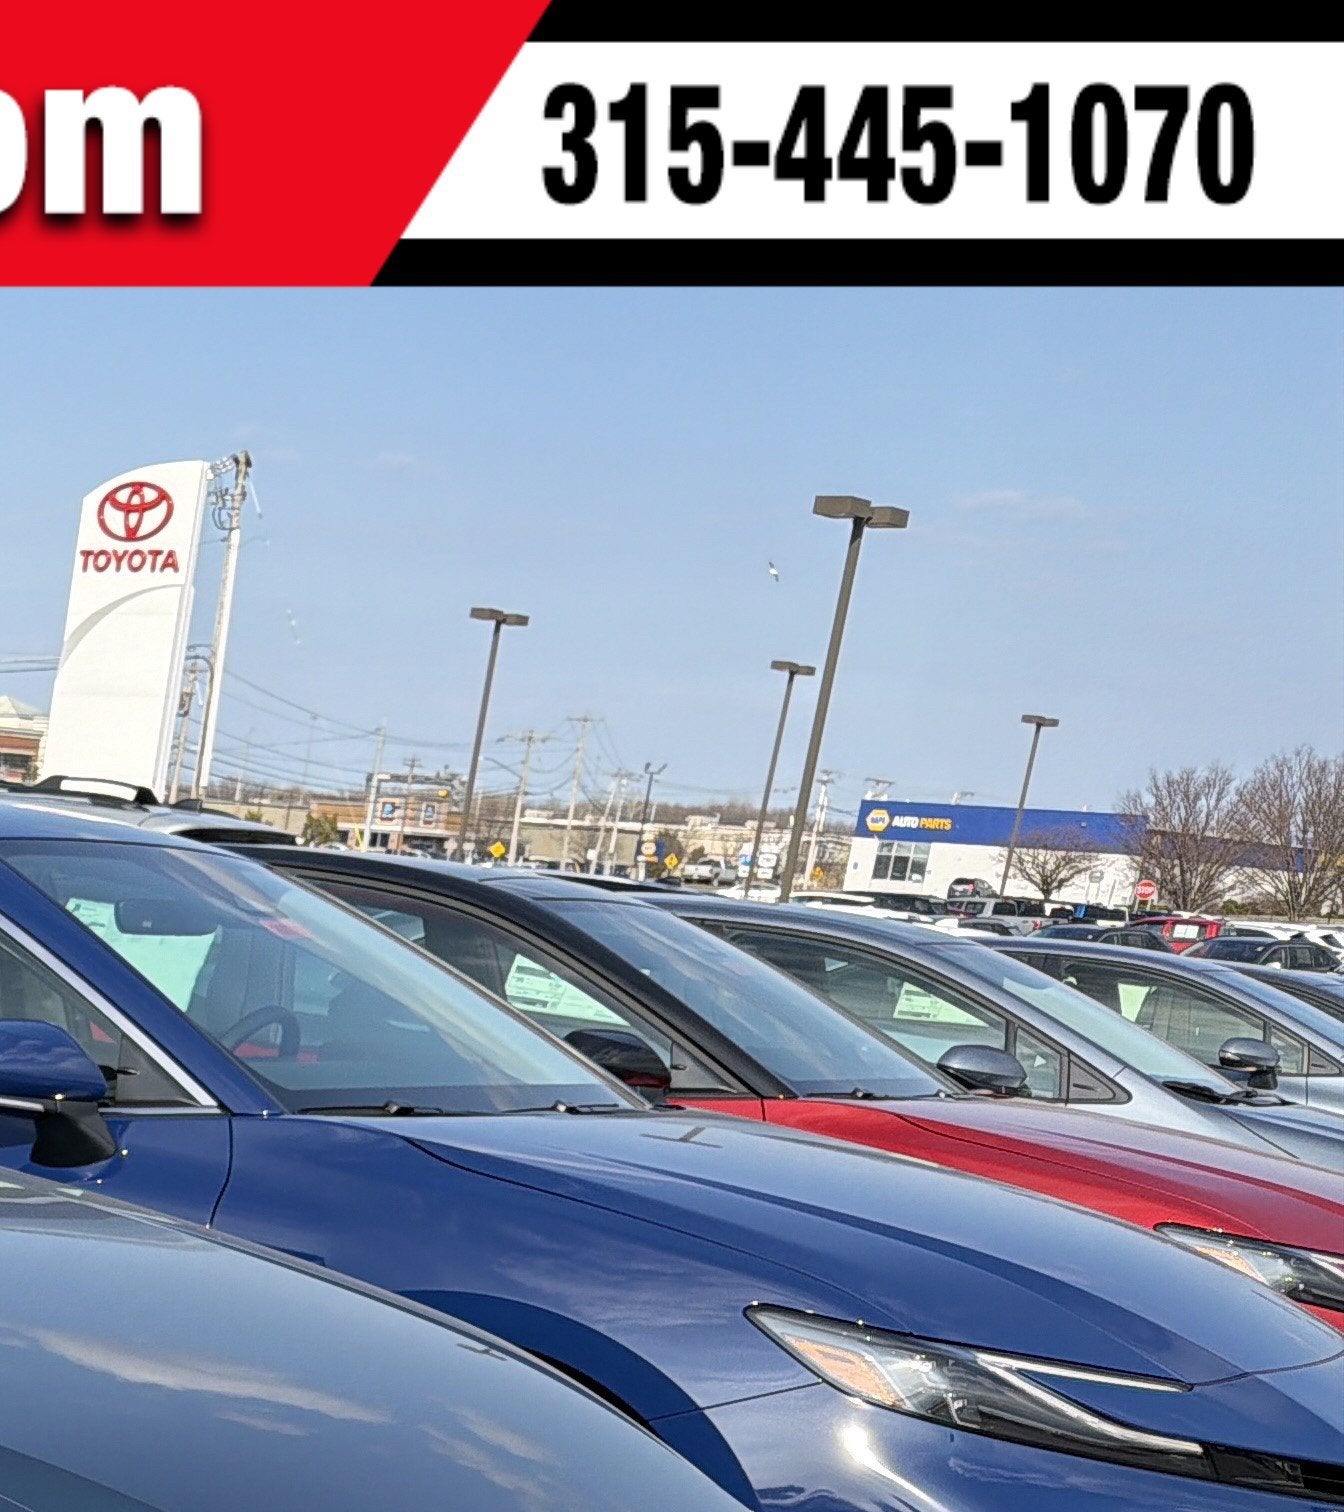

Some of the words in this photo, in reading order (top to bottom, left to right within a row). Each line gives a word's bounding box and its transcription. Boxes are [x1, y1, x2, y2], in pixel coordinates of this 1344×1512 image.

[79, 548, 180, 573] TOYOTA
[891, 815, 920, 829] AUTO
[919, 817, 953, 832] PARTS
